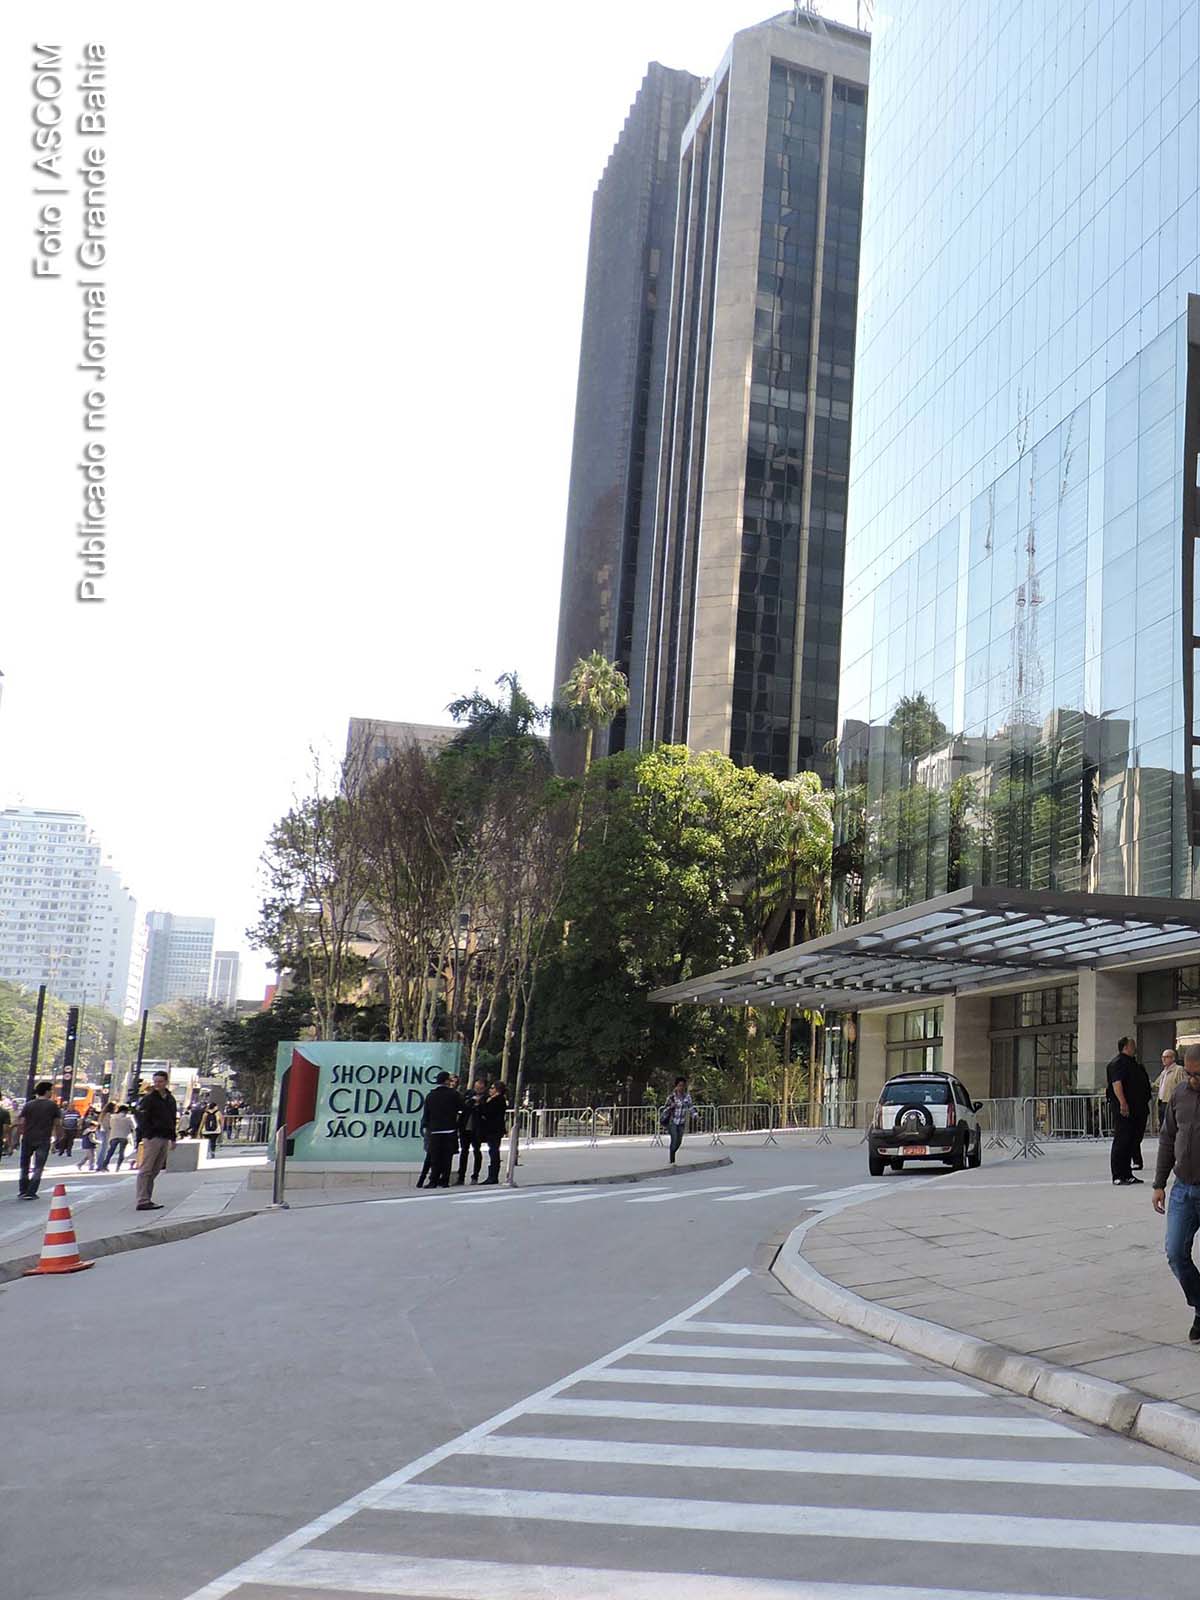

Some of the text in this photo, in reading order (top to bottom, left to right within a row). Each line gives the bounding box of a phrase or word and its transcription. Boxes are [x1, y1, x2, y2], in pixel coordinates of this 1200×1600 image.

[331, 1065, 443, 1085] SHOPPING
[329, 1088, 426, 1114] CIDAD
[326, 1115, 367, 1138] SÃO
